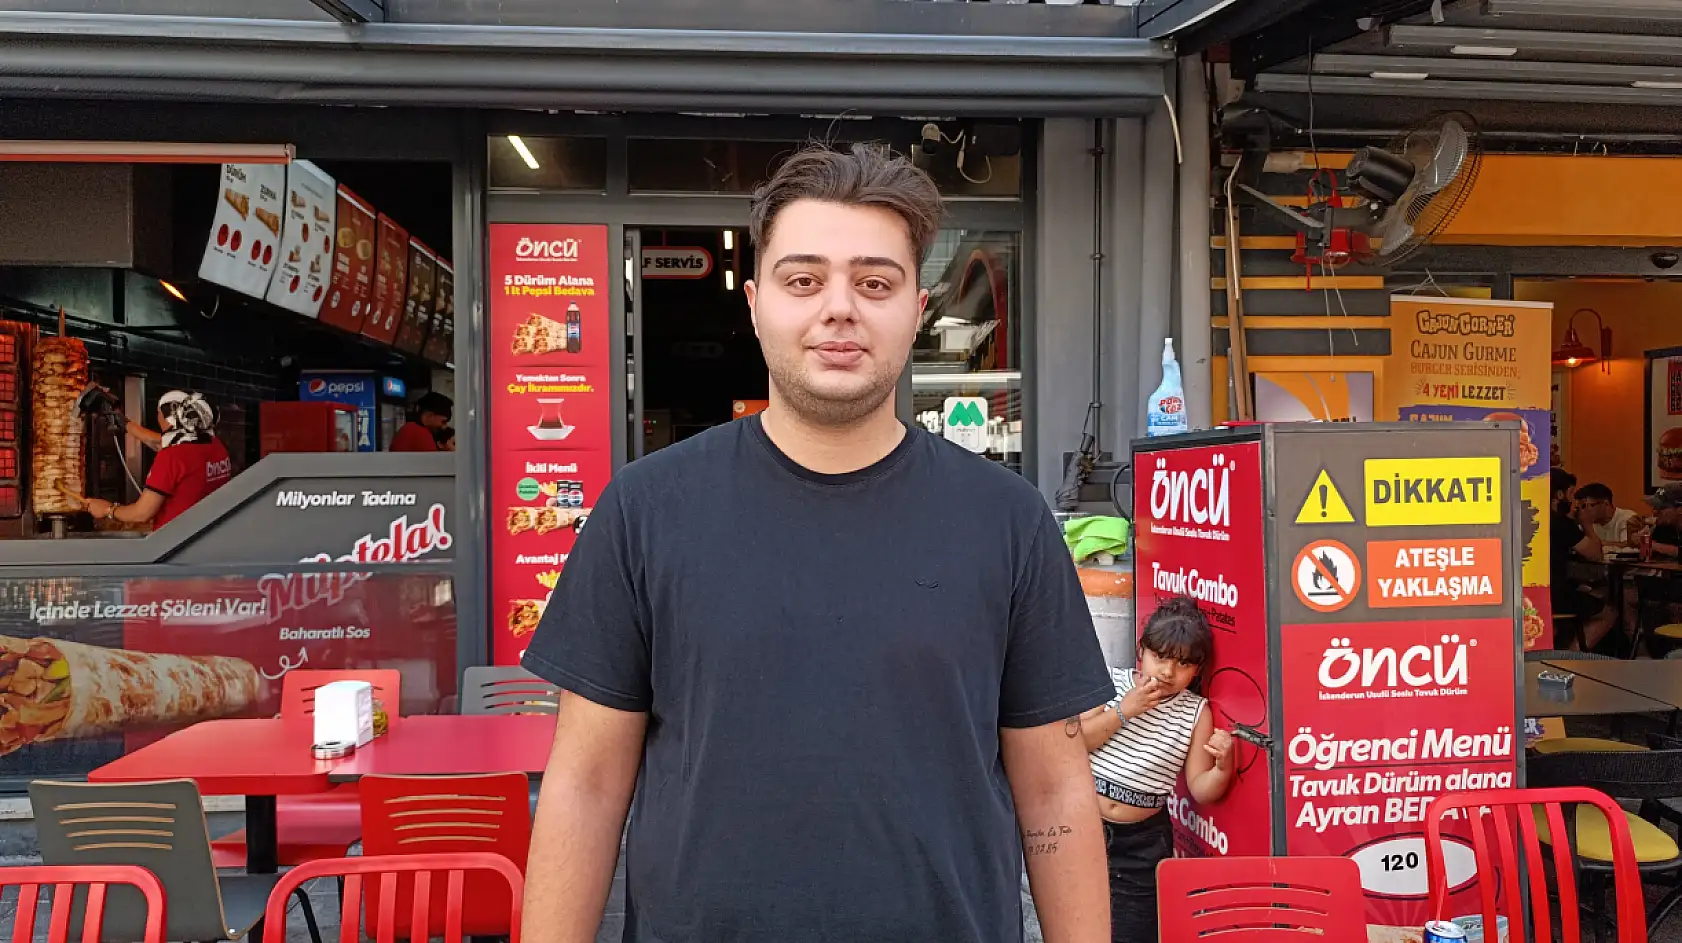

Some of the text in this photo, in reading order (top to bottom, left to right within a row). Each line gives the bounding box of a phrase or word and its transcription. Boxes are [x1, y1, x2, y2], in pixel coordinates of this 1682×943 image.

[656, 254, 704, 268] SERVİS
[504, 275, 594, 286] 5 Dürüm Alana
[504, 286, 510, 295] 1
[522, 286, 552, 298] Pepsi
[554, 286, 594, 296] Bedava
[1411, 340, 1517, 363] CAJUN GURME
[1410, 362, 1452, 376] BURGER
[328, 381, 364, 394] pepsi
[1422, 382, 1506, 400] 4 YENİ LEZZET
[548, 462, 578, 474] Menü
[1374, 472, 1492, 504] DİKKAT!
[276, 491, 416, 510] Milyonlar Tadına
[515, 553, 558, 566] Avantaj
[1395, 546, 1474, 571] ATEŞLE
[1152, 562, 1239, 608] Tavuk Combo
[1378, 576, 1494, 600] YAKLAŞMA
[30, 597, 268, 622] İçinde Lezzet Şöleni Var!
[279, 625, 370, 640] Baharatlı Sos
[1414, 688, 1439, 698] Tavuk
[1440, 687, 1468, 696] Dürüm
[1288, 726, 1512, 770] Öğrenci Menü
[1290, 768, 1512, 798] Tavuk Dürüm alana
[1180, 797, 1228, 855] Combo
[1296, 802, 1380, 832] Ayran
[1381, 852, 1419, 871] 120
